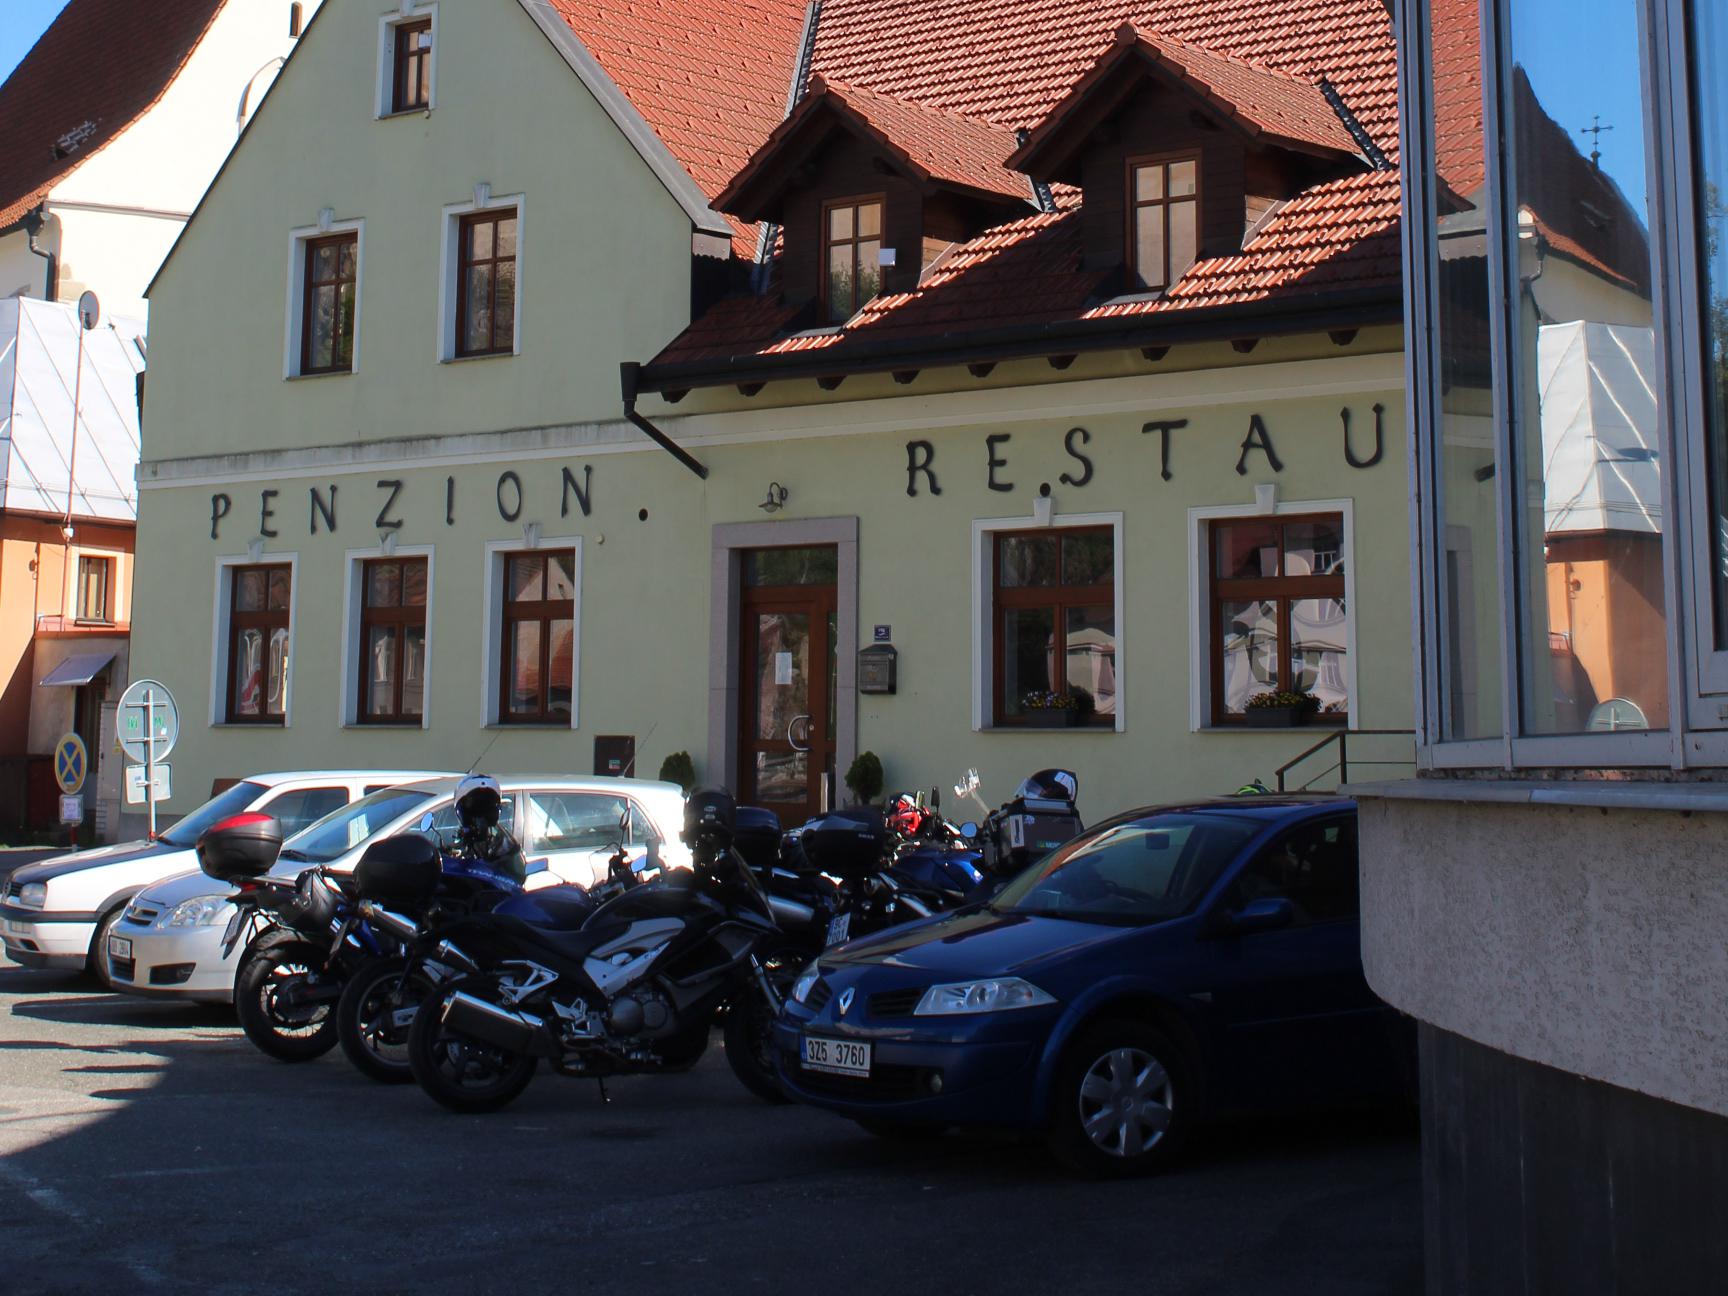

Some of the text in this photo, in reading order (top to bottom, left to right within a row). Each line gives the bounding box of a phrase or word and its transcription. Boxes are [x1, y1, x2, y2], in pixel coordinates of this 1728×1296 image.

[906, 402, 1384, 497] RESTAU
[210, 464, 593, 540] PENZION
[808, 1040, 865, 1066] 3Z5 3760
